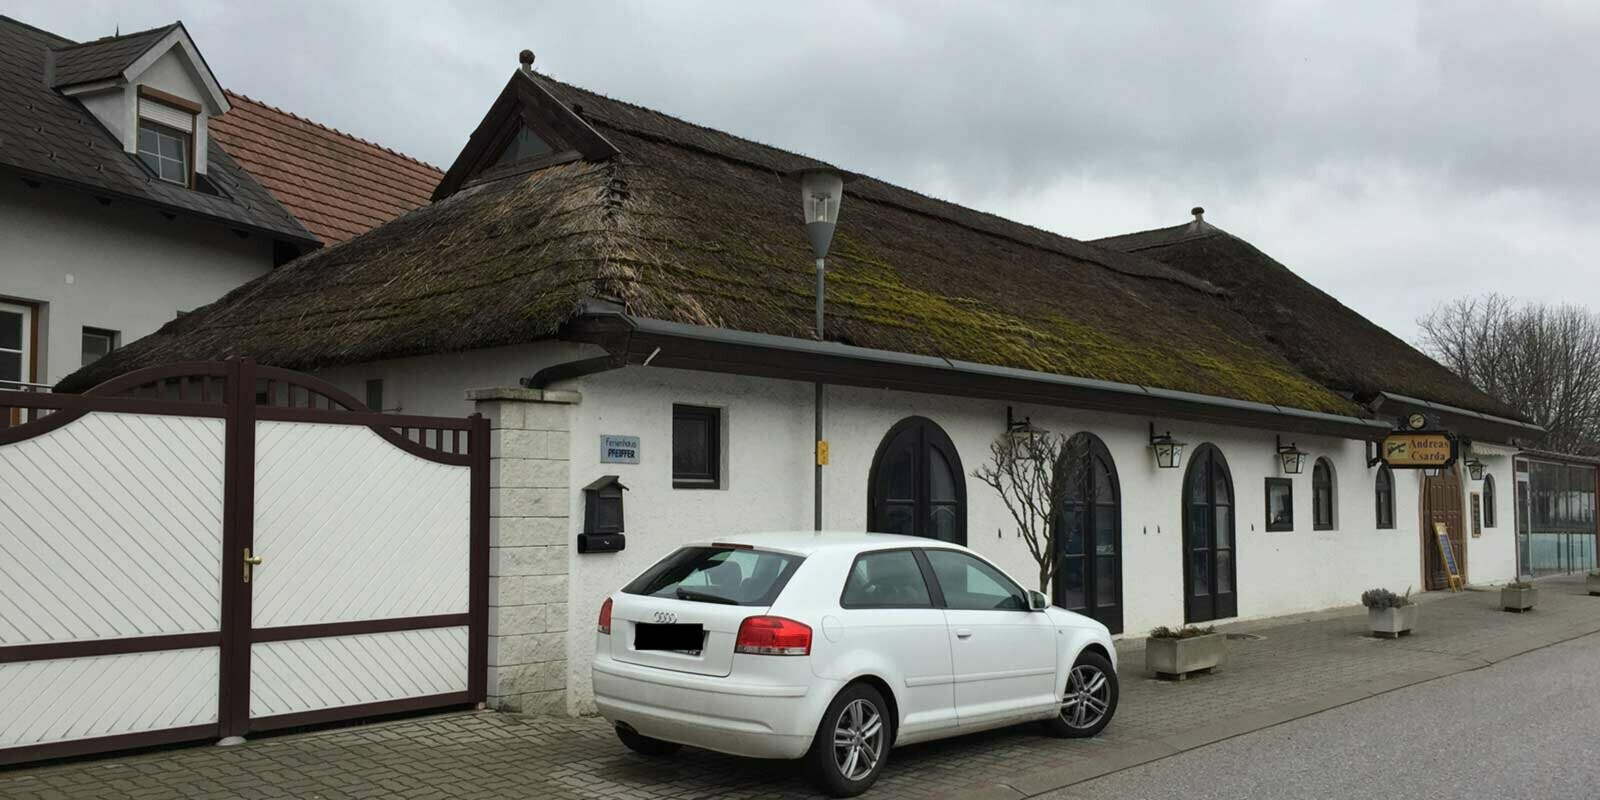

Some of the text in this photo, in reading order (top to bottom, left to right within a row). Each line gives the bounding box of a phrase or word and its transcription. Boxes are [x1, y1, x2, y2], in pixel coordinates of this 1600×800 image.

[1408, 439, 1449, 449] Andreas
[607, 449, 635, 459] PFEIFFER
[1411, 451, 1446, 461] Csarda
